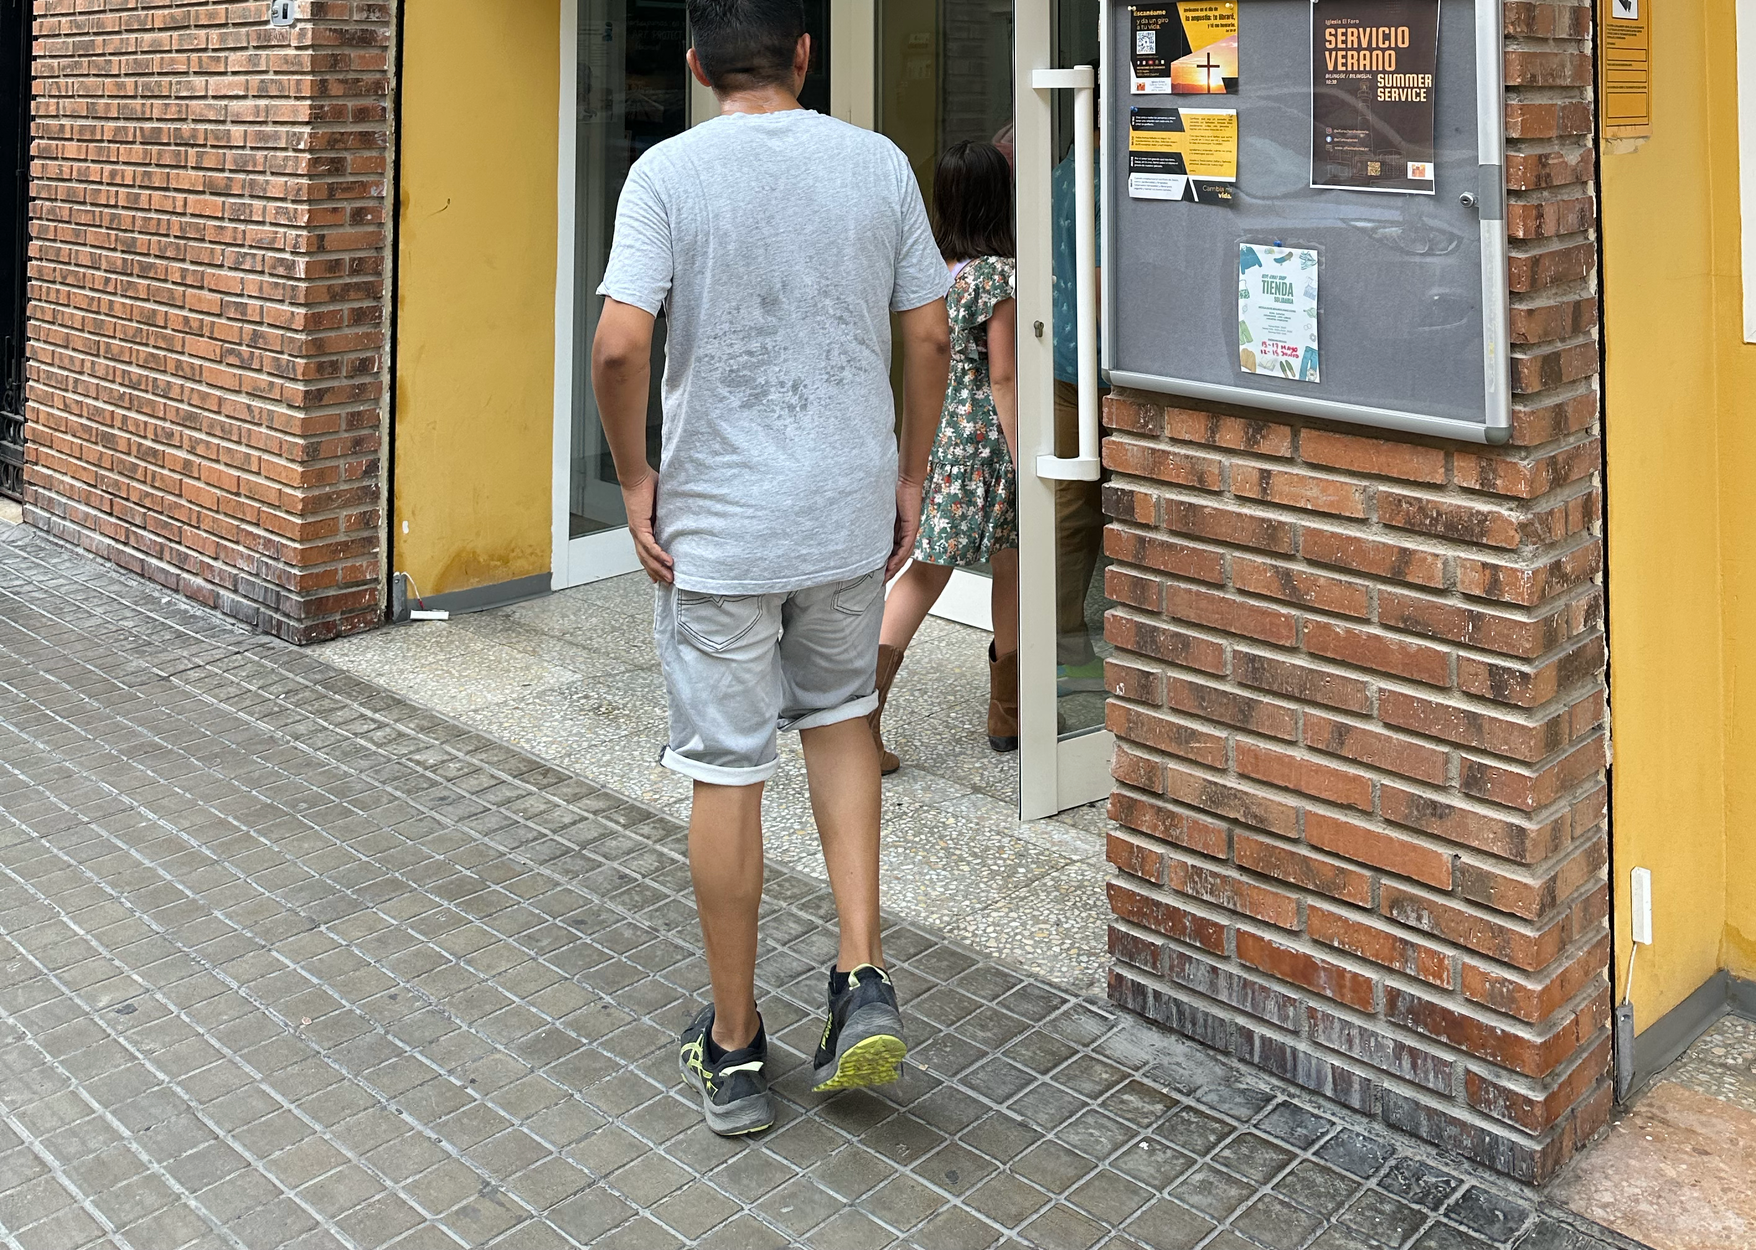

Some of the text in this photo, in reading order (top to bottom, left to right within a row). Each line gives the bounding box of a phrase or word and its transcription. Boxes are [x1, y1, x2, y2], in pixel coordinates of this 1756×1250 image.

[1325, 26, 1410, 48] SERVICIO
[1325, 50, 1396, 71] VERANO
[1377, 74, 1432, 87] SUMMER
[1377, 88, 1427, 102] SERVICE
[1261, 280, 1294, 297] TIENDA
